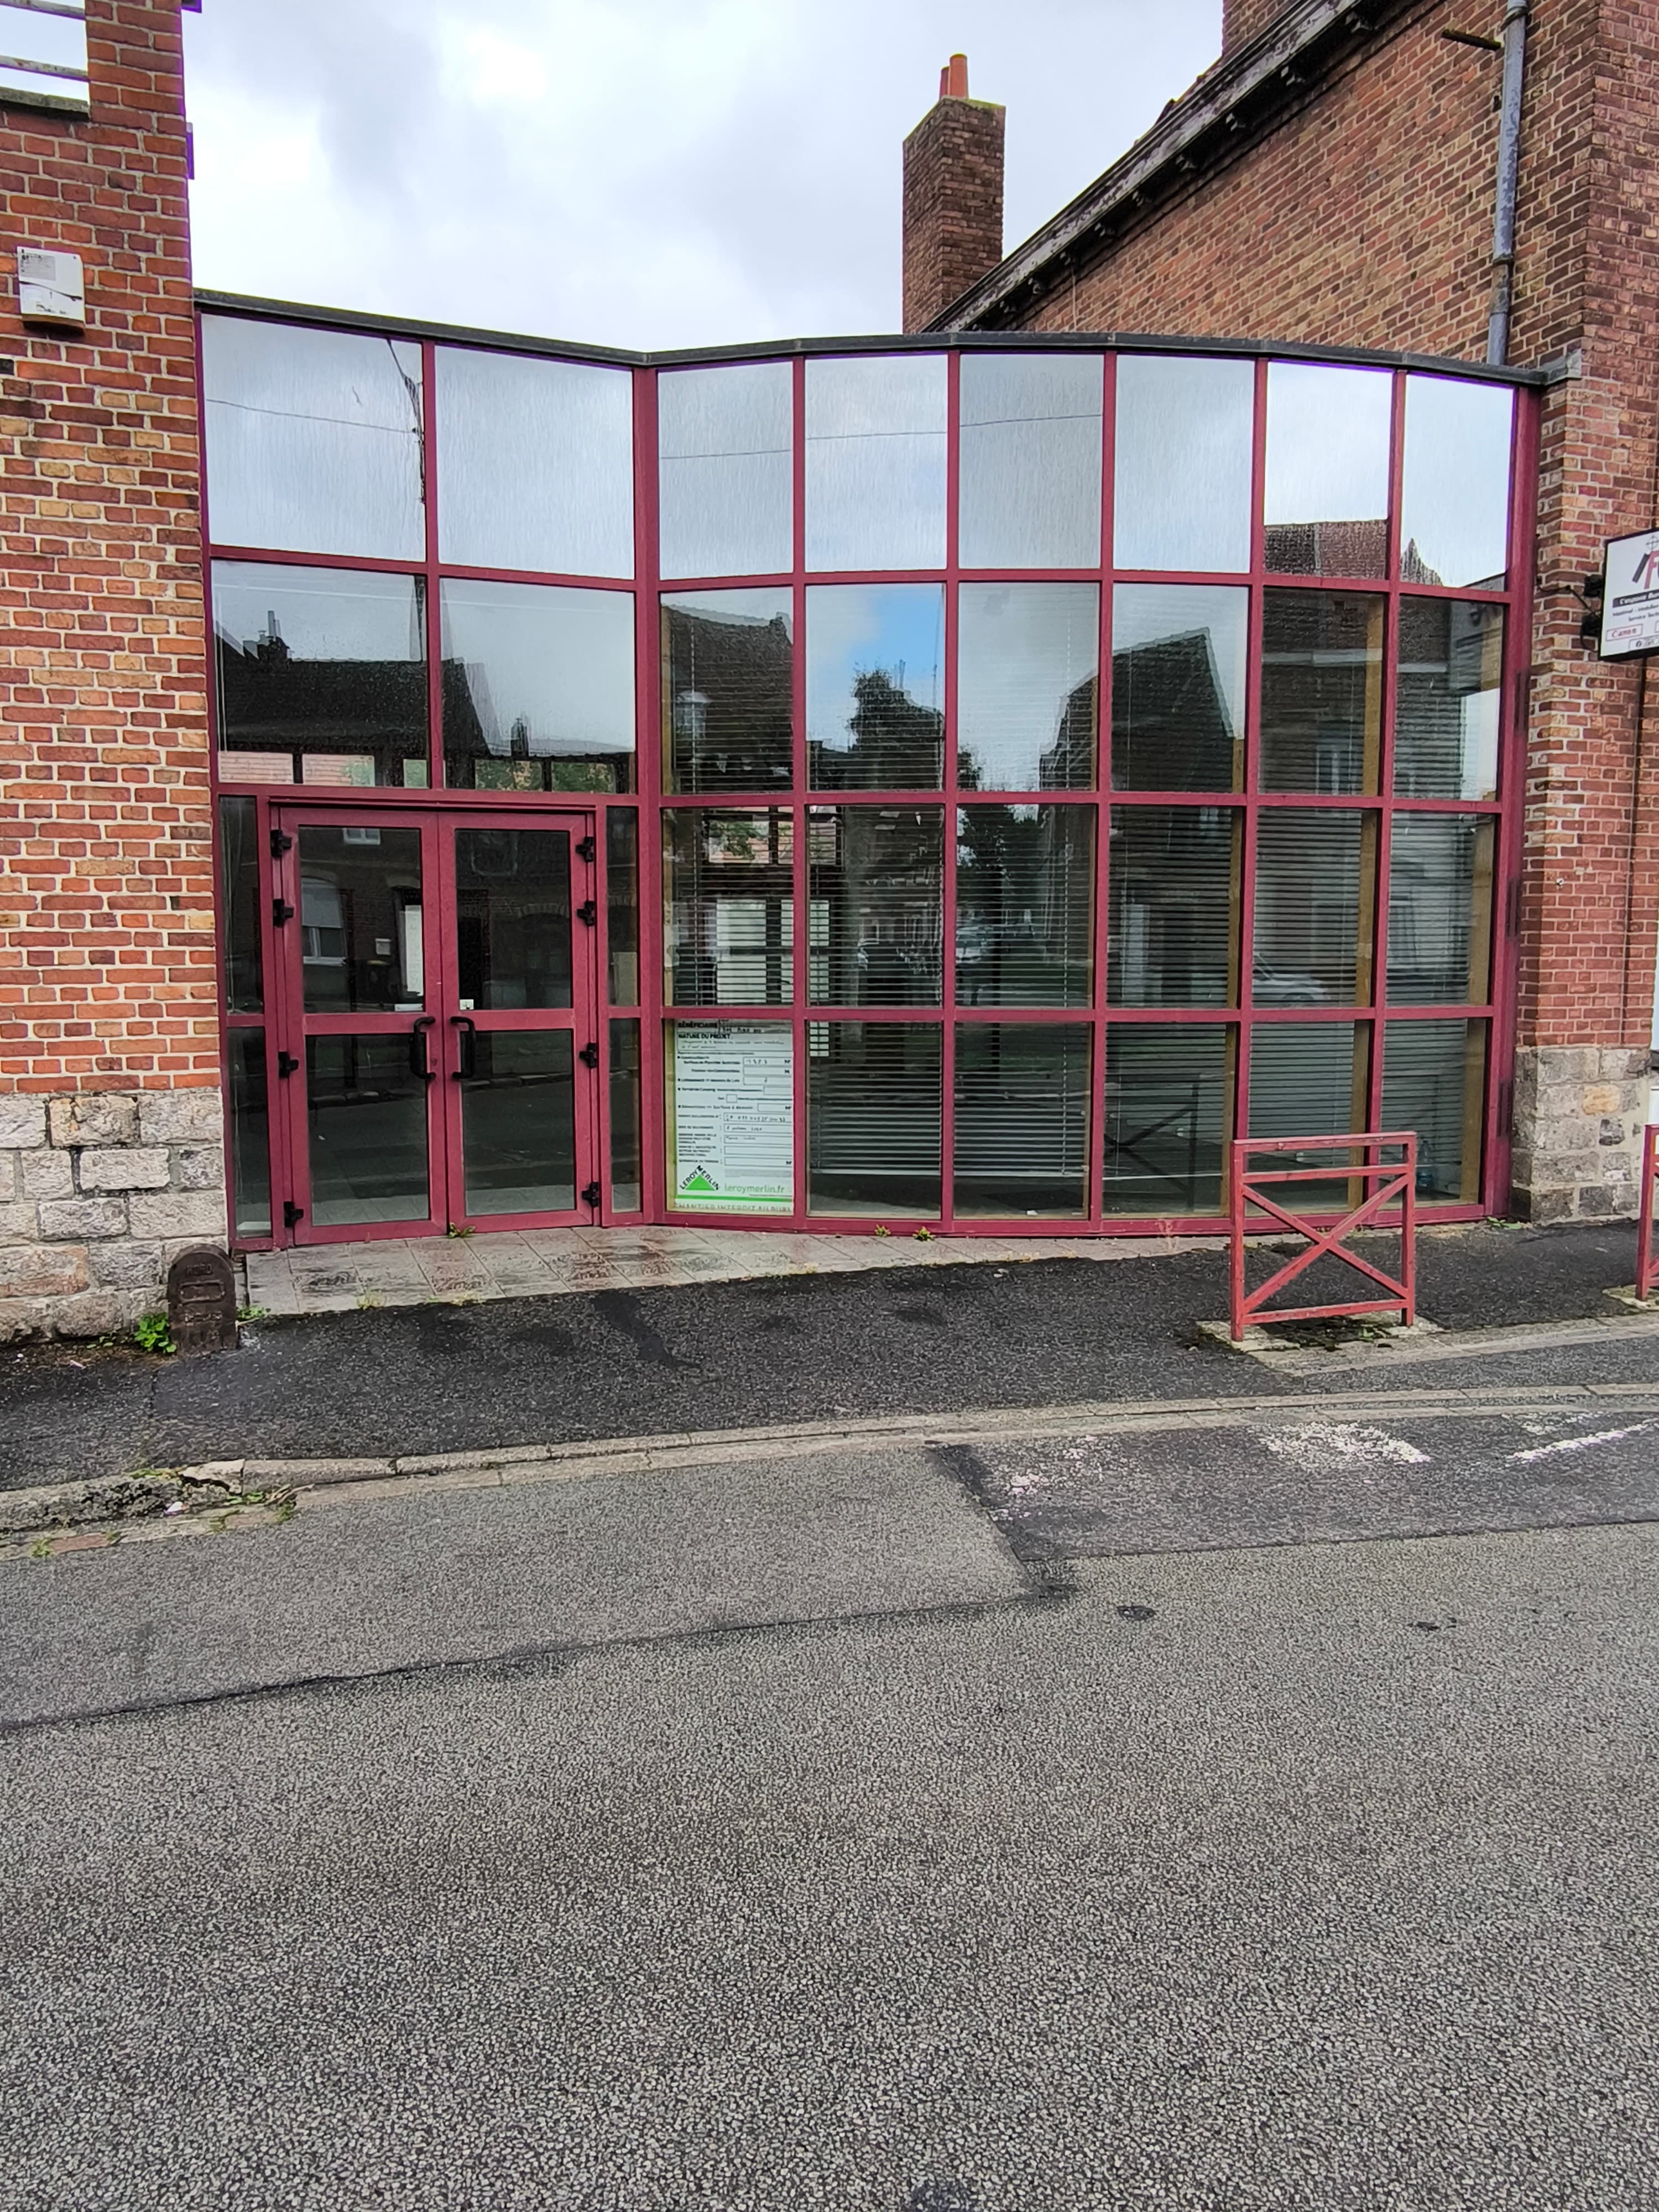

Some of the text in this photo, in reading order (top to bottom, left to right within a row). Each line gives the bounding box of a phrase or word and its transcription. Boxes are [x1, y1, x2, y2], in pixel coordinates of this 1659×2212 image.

[680, 1165, 719, 1191] LEROY MERLIN
[724, 1183, 785, 1193] leroymerlin.fr
